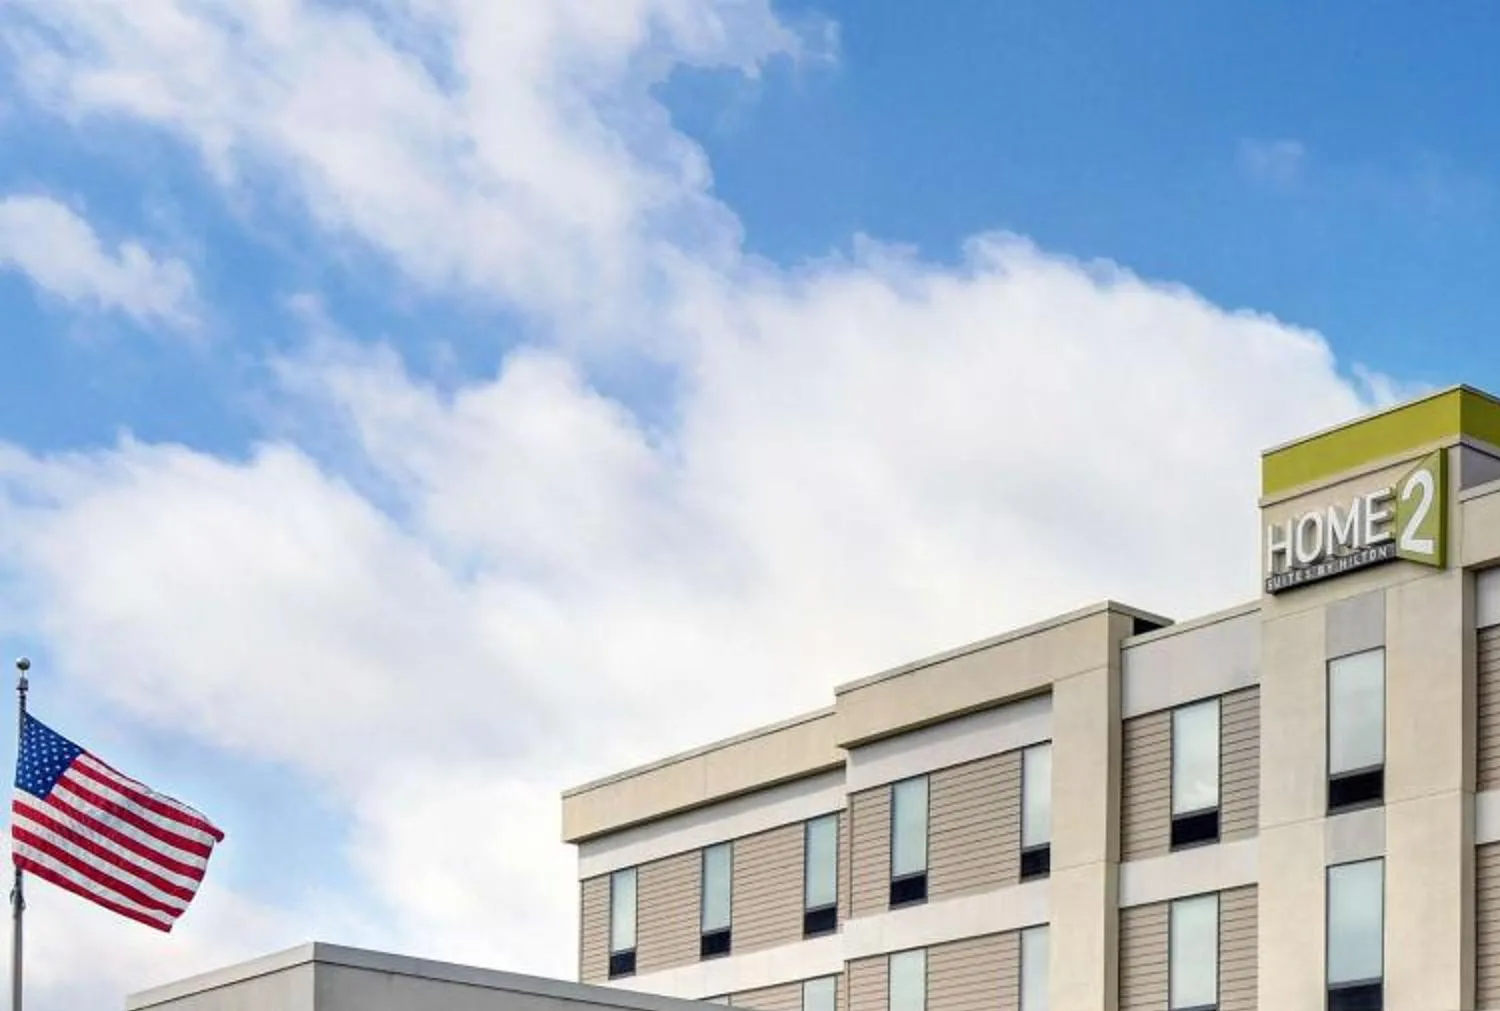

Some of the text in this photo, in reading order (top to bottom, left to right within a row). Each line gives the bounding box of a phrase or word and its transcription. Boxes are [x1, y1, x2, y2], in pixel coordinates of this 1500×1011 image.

[1267, 469, 1434, 572] HOME 2
[1267, 567, 1312, 591] SUITES
[1339, 547, 1388, 570] HILTON
